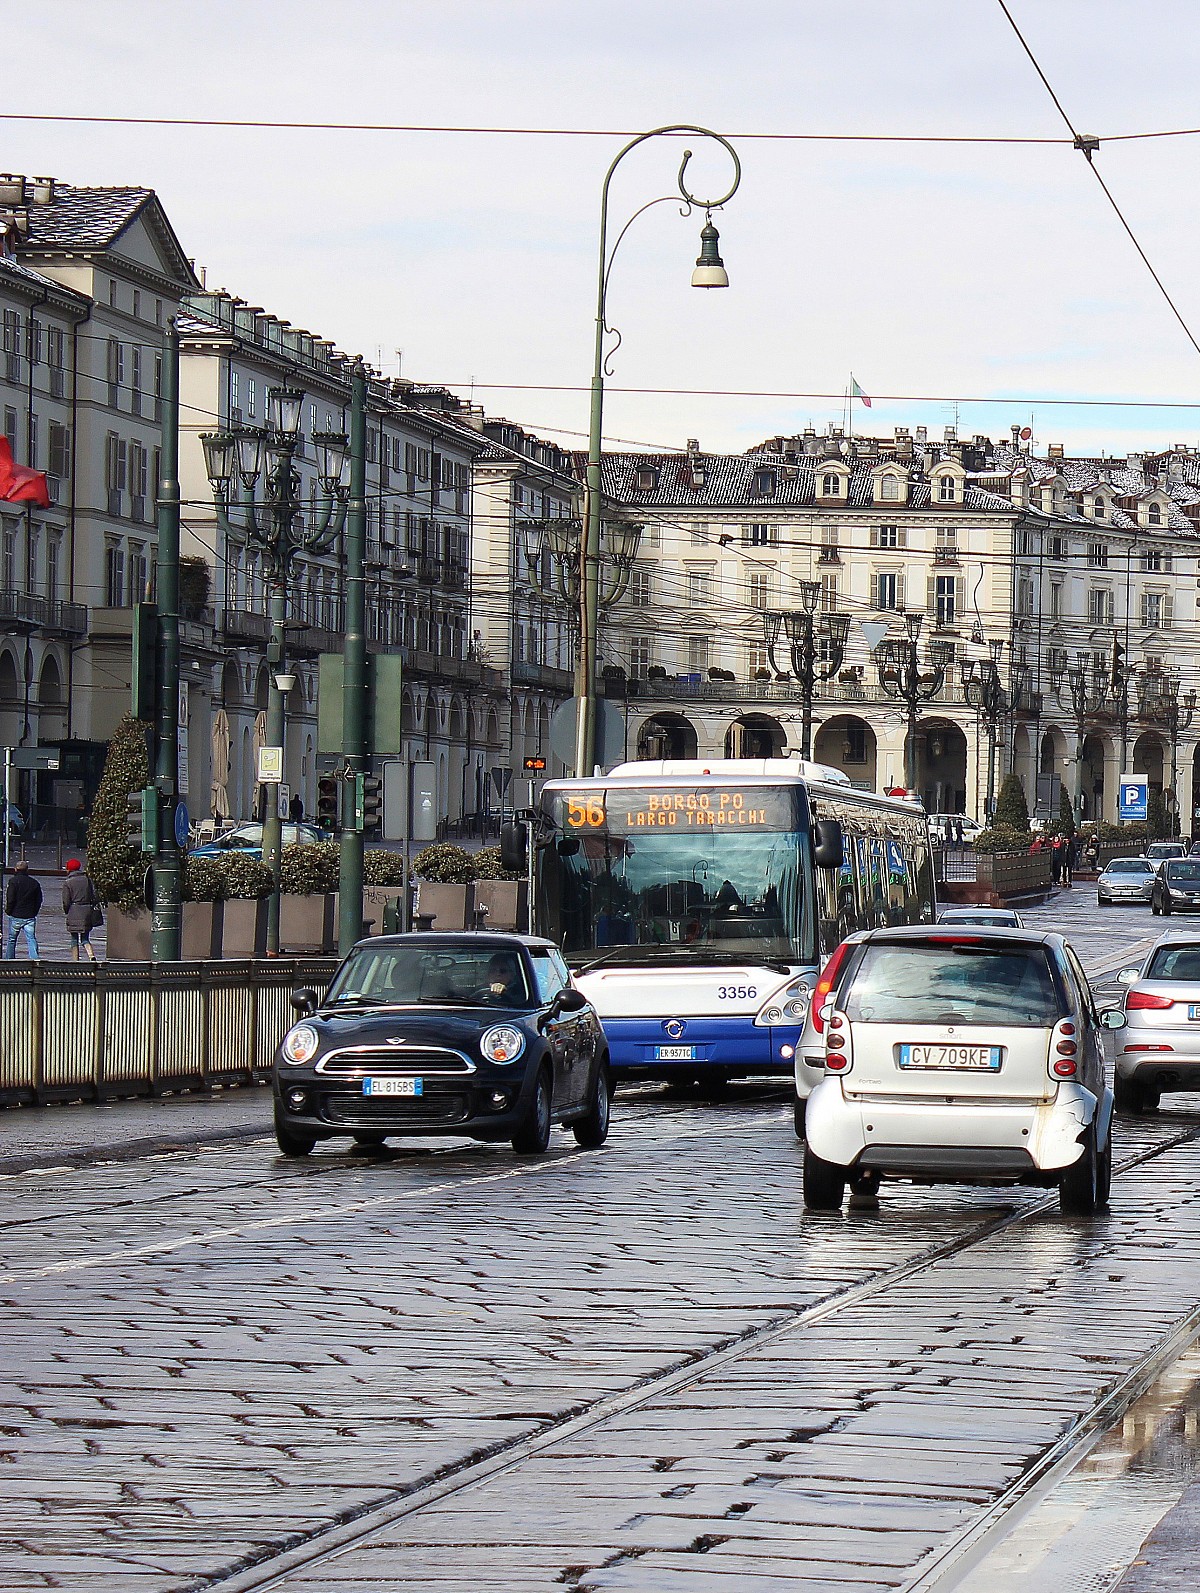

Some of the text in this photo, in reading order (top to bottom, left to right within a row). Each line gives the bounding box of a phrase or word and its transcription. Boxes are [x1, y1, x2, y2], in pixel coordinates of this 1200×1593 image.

[648, 792, 744, 811] BORGO PO
[567, 796, 605, 827] 56
[627, 809, 766, 826] LARGO TABACCHI
[718, 985, 758, 1000] 3356
[912, 1047, 990, 1066] CV 709KE
